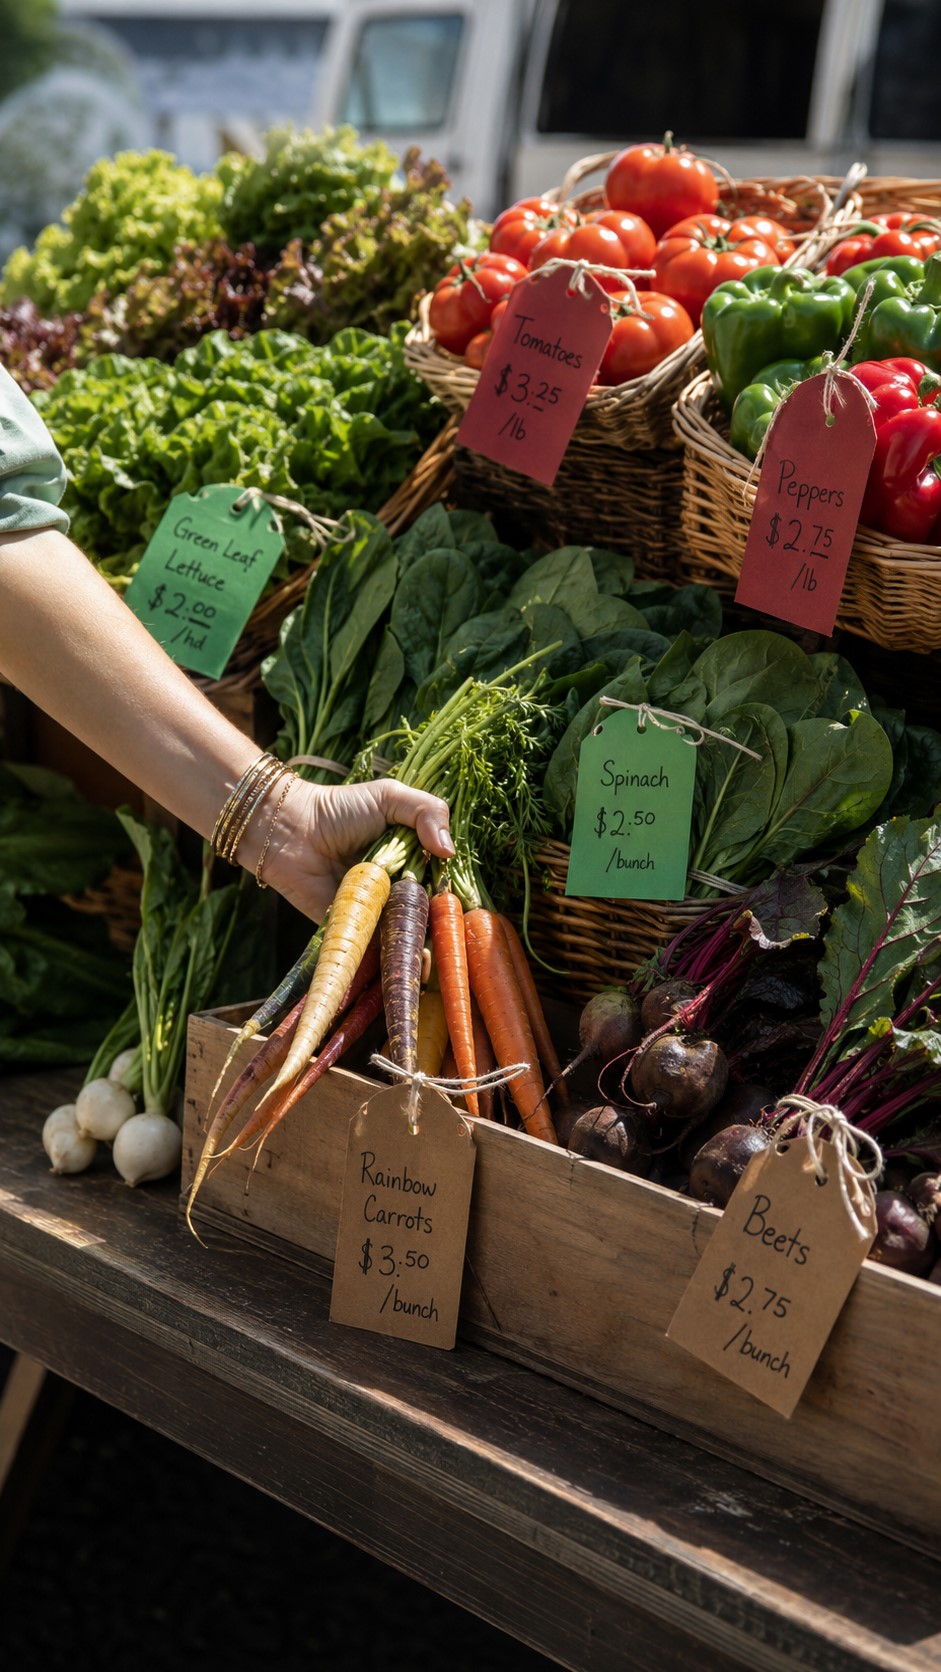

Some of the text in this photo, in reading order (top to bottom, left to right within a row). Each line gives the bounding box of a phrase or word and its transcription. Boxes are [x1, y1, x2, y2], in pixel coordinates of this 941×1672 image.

[513, 314, 583, 369] Tomatoes
[498, 412, 527, 441] /lb
[777, 459, 845, 510] Peppers
[173, 516, 264, 572] Green Leaf
[765, 512, 834, 553] $2.75
[164, 549, 226, 591] Lettuce
[791, 563, 817, 592] /lb
[170, 626, 208, 650] /hd
[600, 759, 669, 796] Spinach
[605, 847, 655, 873] /bunch
[361, 1151, 437, 1197] Rainbow
[363, 1194, 433, 1234] Carrots
[742, 1194, 811, 1265] Beets
[379, 1283, 438, 1322] /bunch
[714, 1262, 791, 1318] $2.75
[723, 1323, 791, 1379] /bunch
